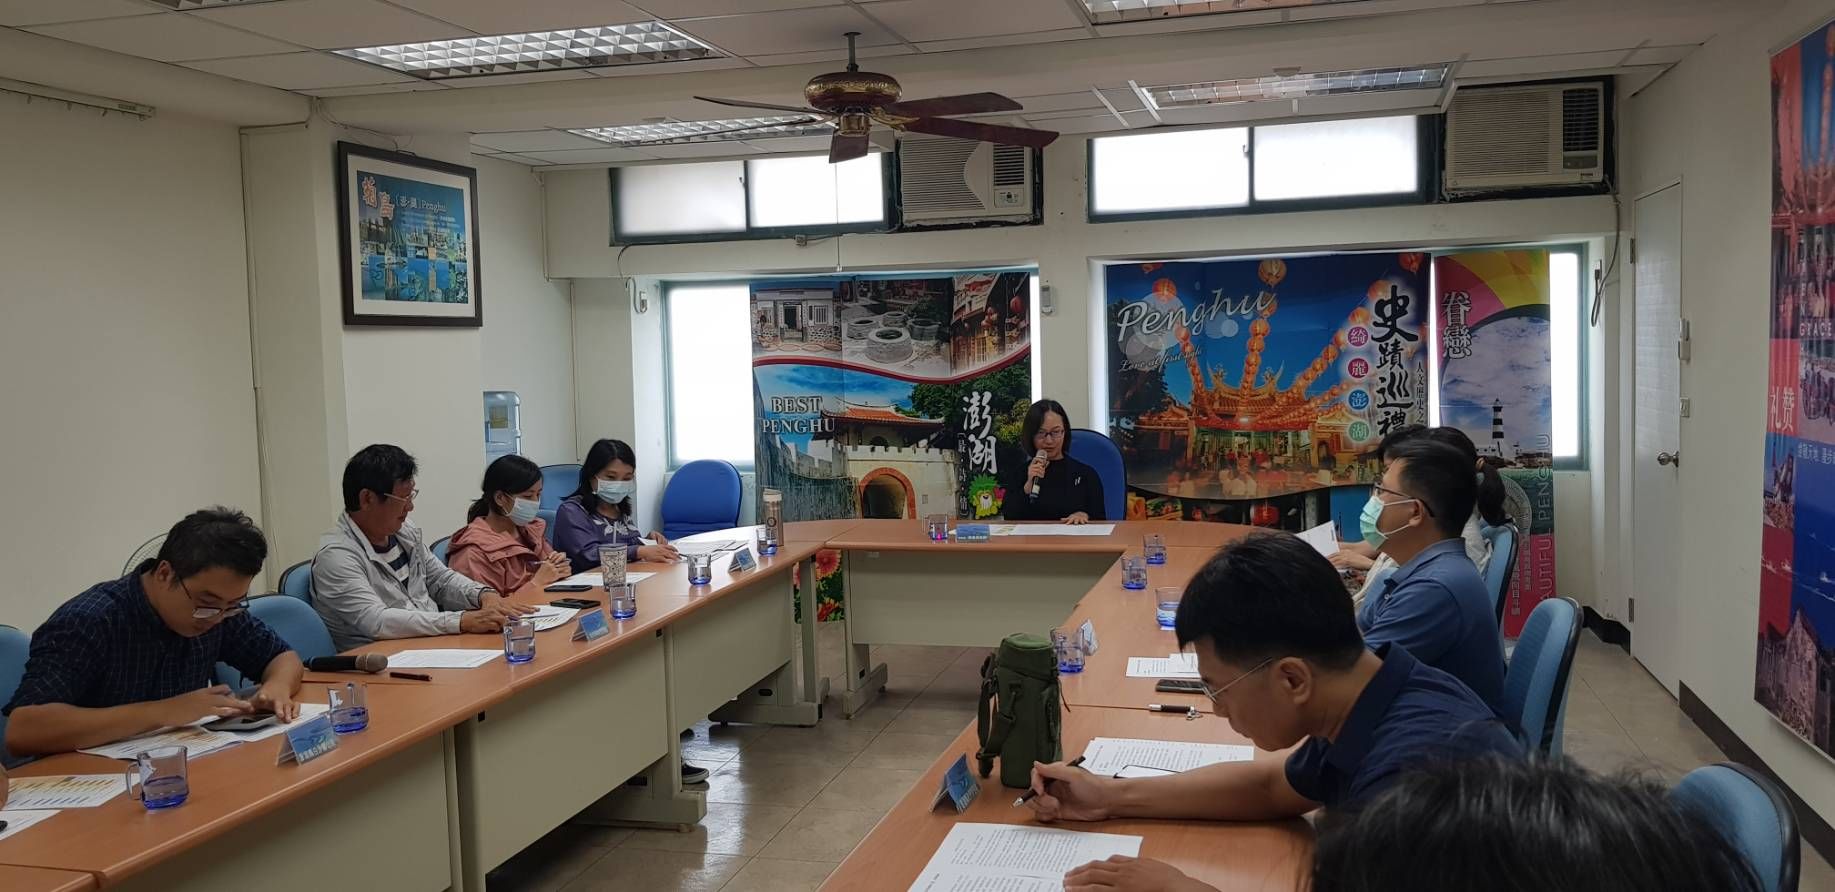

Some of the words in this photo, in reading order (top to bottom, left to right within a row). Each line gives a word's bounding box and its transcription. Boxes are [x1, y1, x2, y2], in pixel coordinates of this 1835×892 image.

[1117, 288, 1277, 342] Penghu
[1118, 359, 1145, 372] Love
[771, 396, 823, 414] BEST
[762, 418, 836, 434] PENGHU
[962, 391, 998, 475] 澎湖
